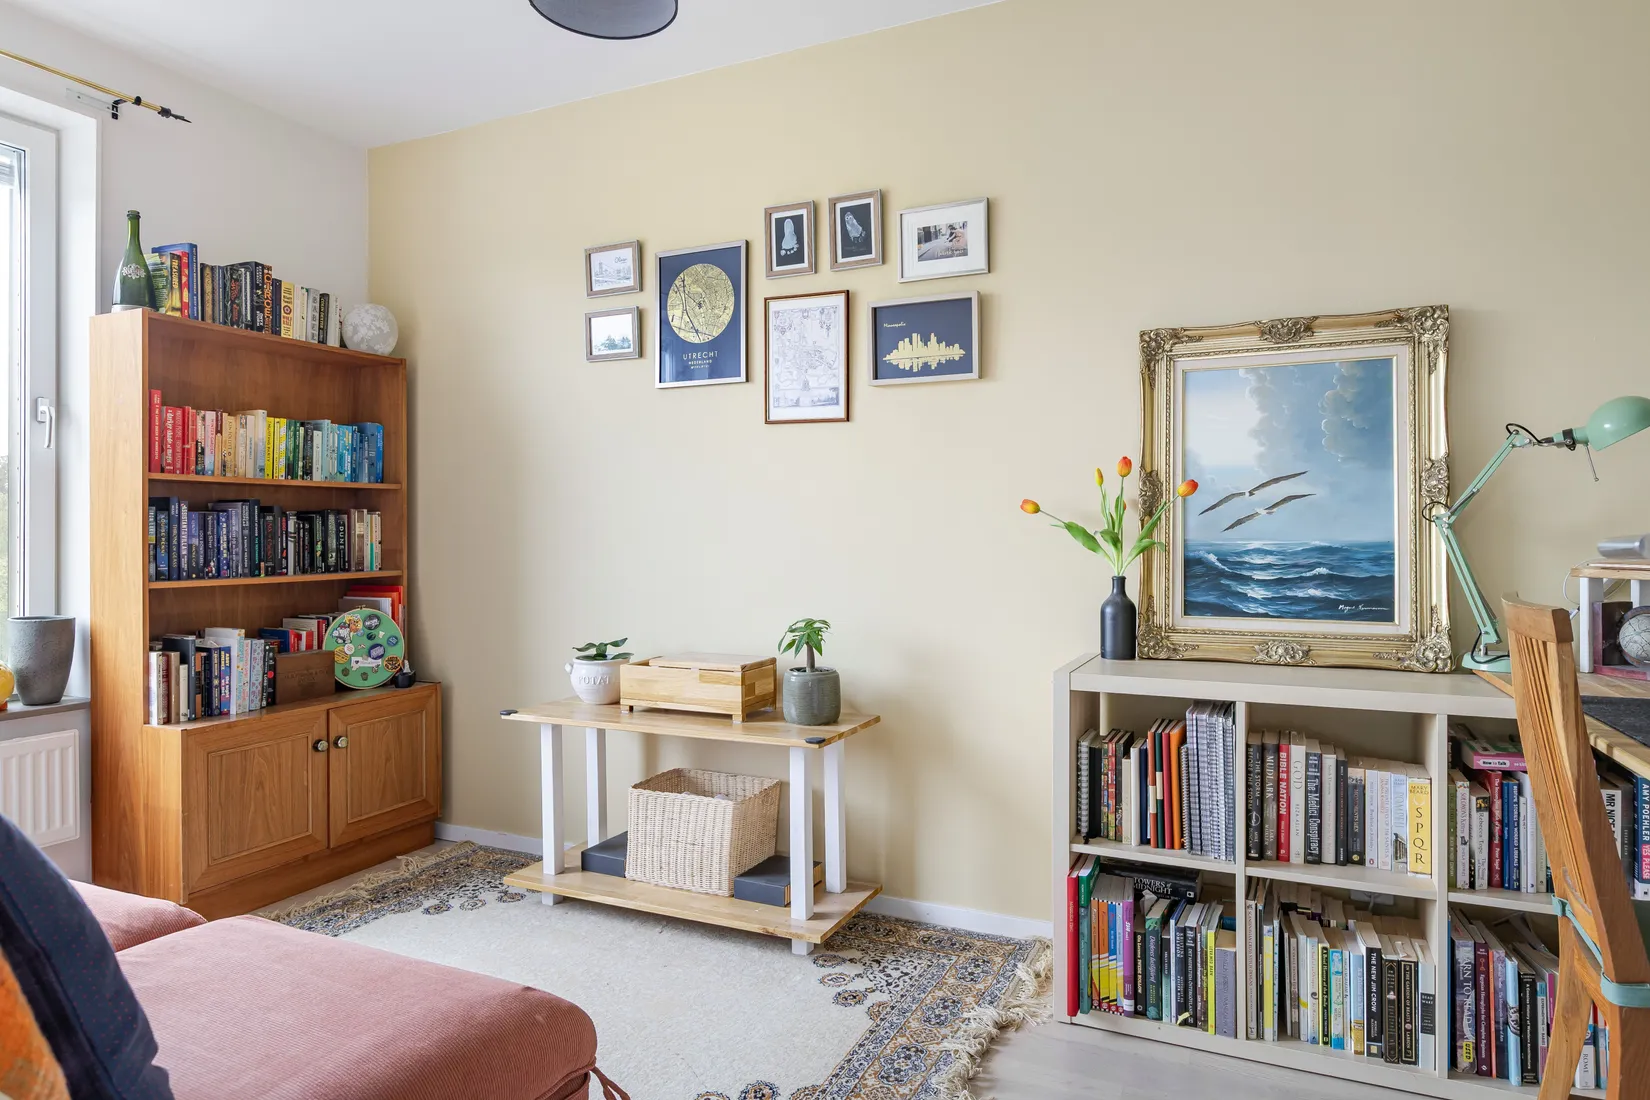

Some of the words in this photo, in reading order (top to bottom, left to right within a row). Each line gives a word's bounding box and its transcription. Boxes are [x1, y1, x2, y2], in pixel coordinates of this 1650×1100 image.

[682, 350, 718, 361] UTRECHT
[1280, 752, 1288, 779] BIBLE
[1293, 760, 1303, 790] GOD
[1265, 755, 1275, 799] MUDLARK
[1307, 778, 1319, 791] The
[1280, 781, 1288, 815] NATION
[1307, 793, 1319, 816] Medici
[1606, 794, 1616, 807] MR
[1307, 818, 1321, 854] Conspiracy
[1642, 844, 1650, 856] YES
[1642, 858, 1650, 880] PLEASE
[1134, 877, 1166, 888] TOWERS
[1464, 981, 1472, 995] TO
